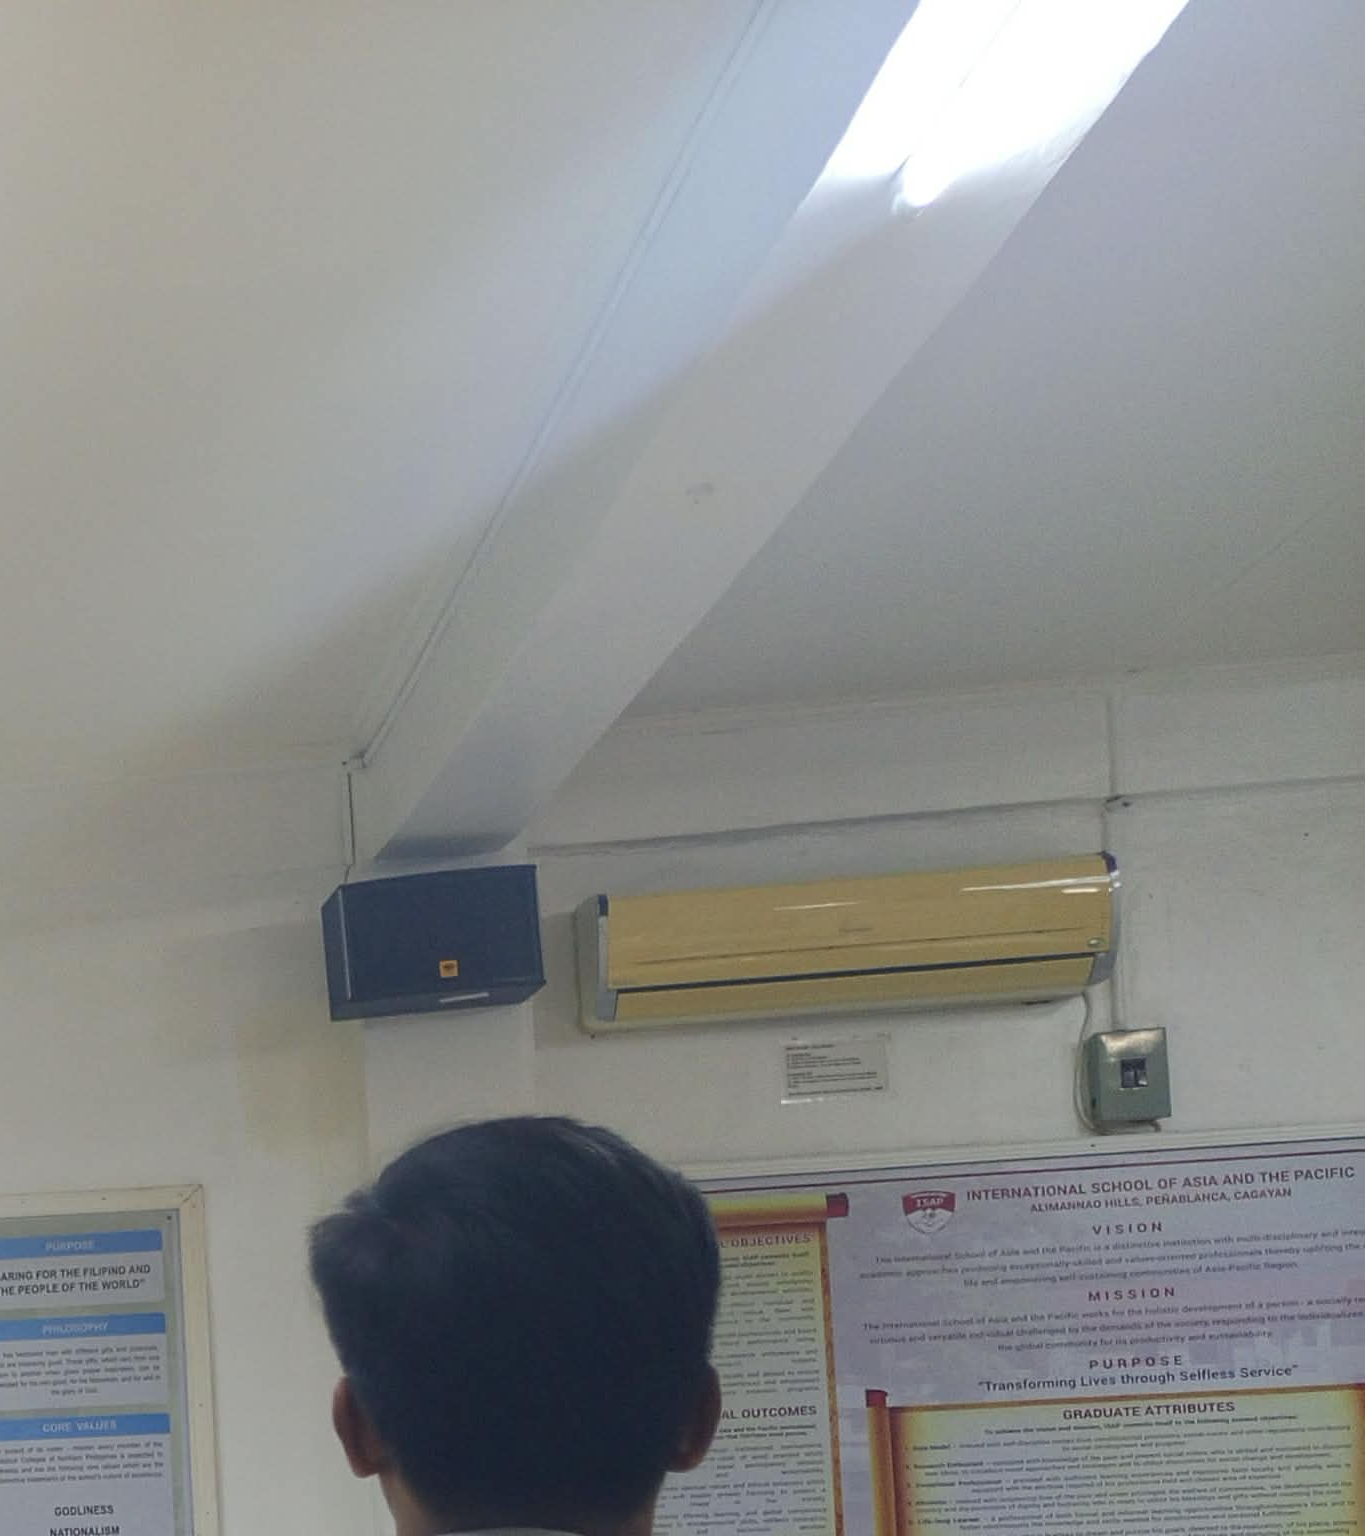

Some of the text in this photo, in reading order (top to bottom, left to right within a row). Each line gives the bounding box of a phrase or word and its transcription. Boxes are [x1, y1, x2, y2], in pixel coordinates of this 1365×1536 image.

[967, 1166, 1355, 1201] INTERNATIONAL SCHOOL OF ASIA AND THE PACIFIC
[1030, 1199, 1101, 1213] ALIMANNAO
[1104, 1196, 1143, 1209] HILLS,
[1234, 1187, 1292, 1201] CAGAYAN
[45, 1240, 95, 1251] PURPOSE
[731, 1233, 812, 1247] OBJECTIVES
[36, 1270, 57, 1280] FOR
[60, 1268, 80, 1278] THE
[83, 1265, 126, 1277] FILIPINO
[128, 1264, 151, 1274] AND
[18, 1283, 59, 1295] PEOPLE
[61, 1282, 76, 1292] OF
[78, 1281, 98, 1291] THE
[101, 1278, 146, 1290] WORLD"
[42, 1322, 109, 1335] PHILOSOPHY
[978, 1364, 1299, 1392] "Transforming Lives through Selfless Service"
[741, 1405, 818, 1419] OUTCOMES
[1063, 1401, 1235, 1421] GRADUATE ATTRIBUTES
[42, 1420, 117, 1433] CORE VALUES
[54, 1505, 114, 1516] GODLINESS
